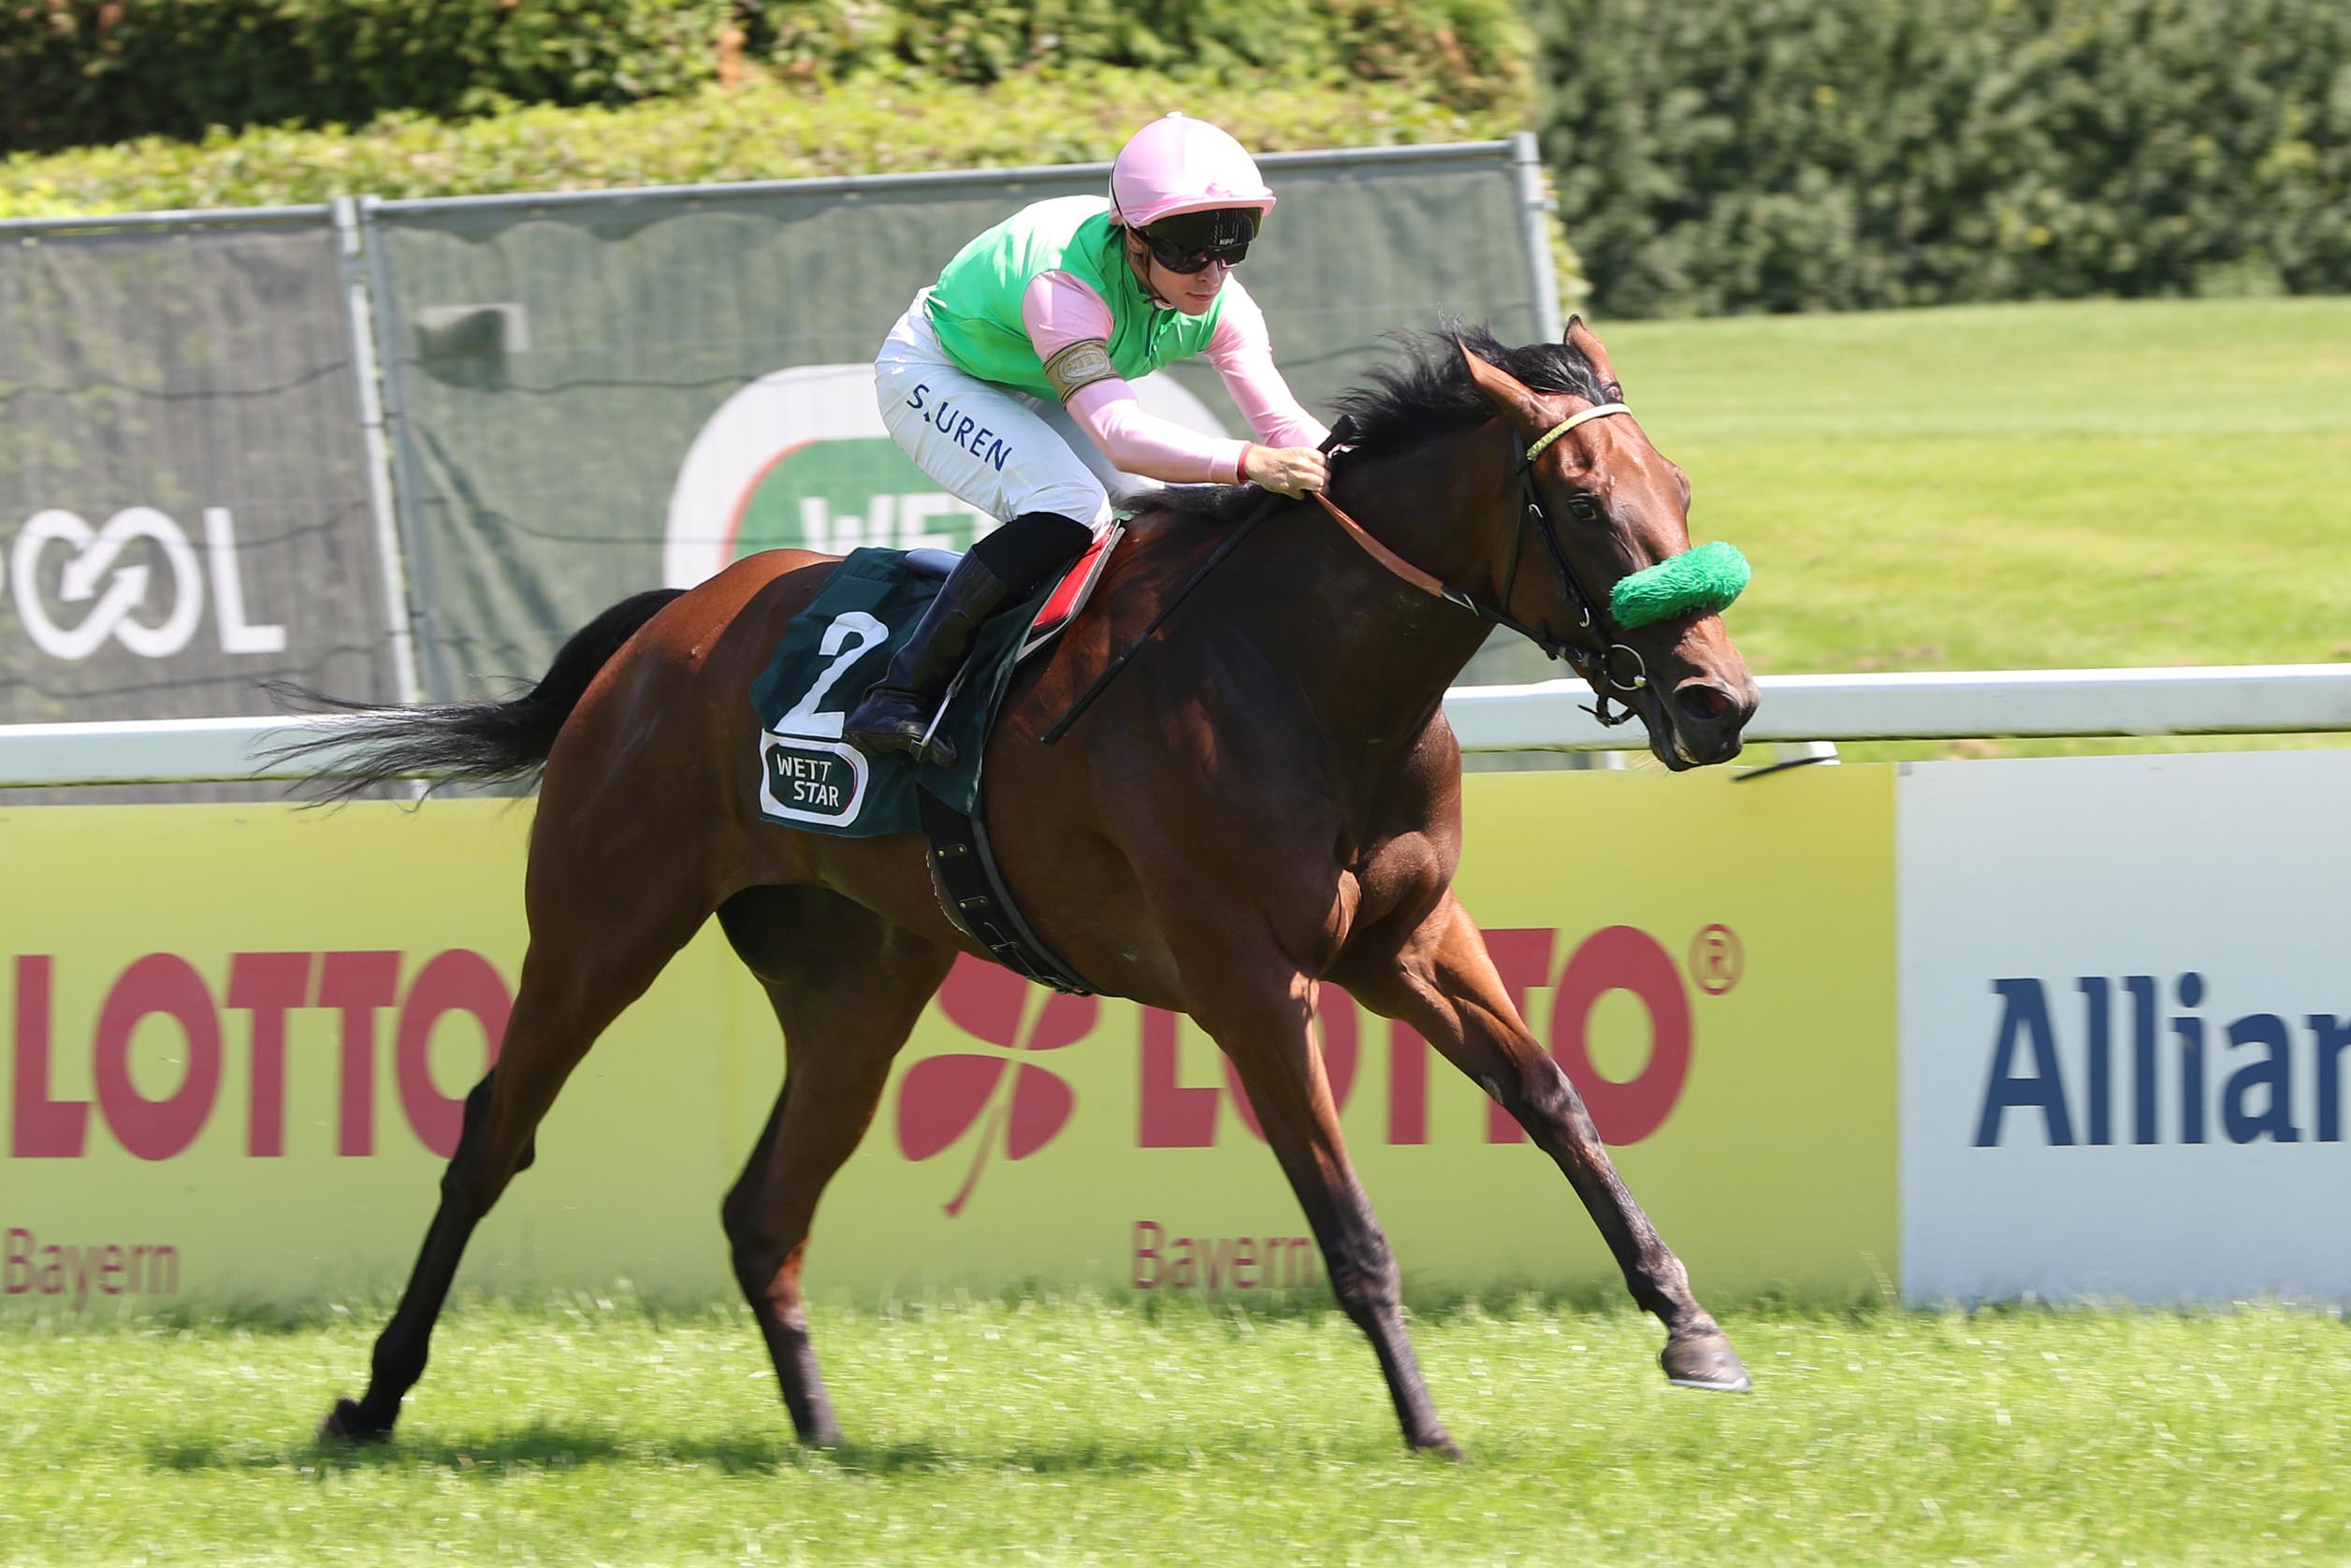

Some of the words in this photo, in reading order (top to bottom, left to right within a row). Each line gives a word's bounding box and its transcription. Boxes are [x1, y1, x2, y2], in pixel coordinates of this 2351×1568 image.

[773, 611, 890, 739] 2
[776, 753, 832, 782] WETT
[793, 780, 839, 807] STAR
[10, 948, 516, 1161] LOTTO
[5, 1227, 181, 1312] Bayern
[1132, 1220, 1315, 1303] Bayern
